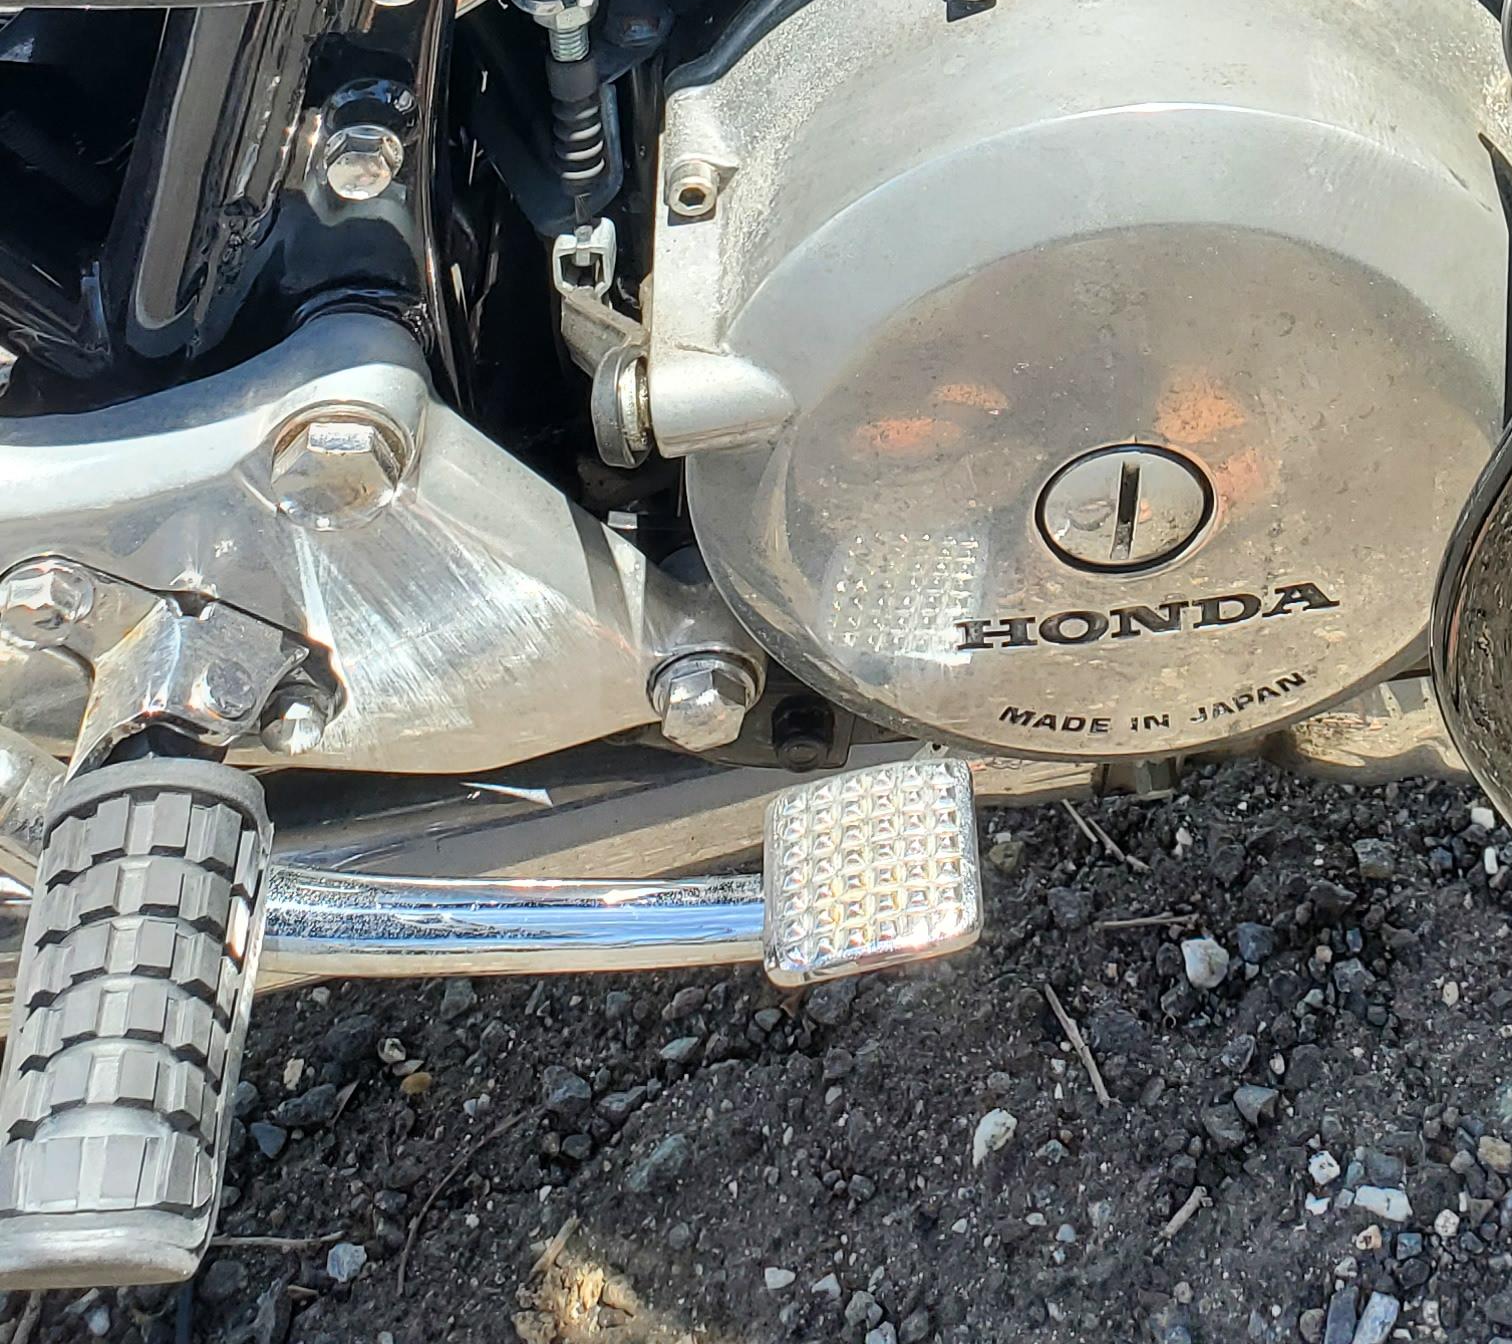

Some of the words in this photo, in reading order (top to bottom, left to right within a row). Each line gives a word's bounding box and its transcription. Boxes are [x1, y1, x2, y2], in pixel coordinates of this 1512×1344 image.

[956, 582, 1340, 651] HONDA
[999, 705, 1112, 734] MADE
[1130, 713, 1170, 732] IN
[1190, 671, 1307, 725] JAPAN
